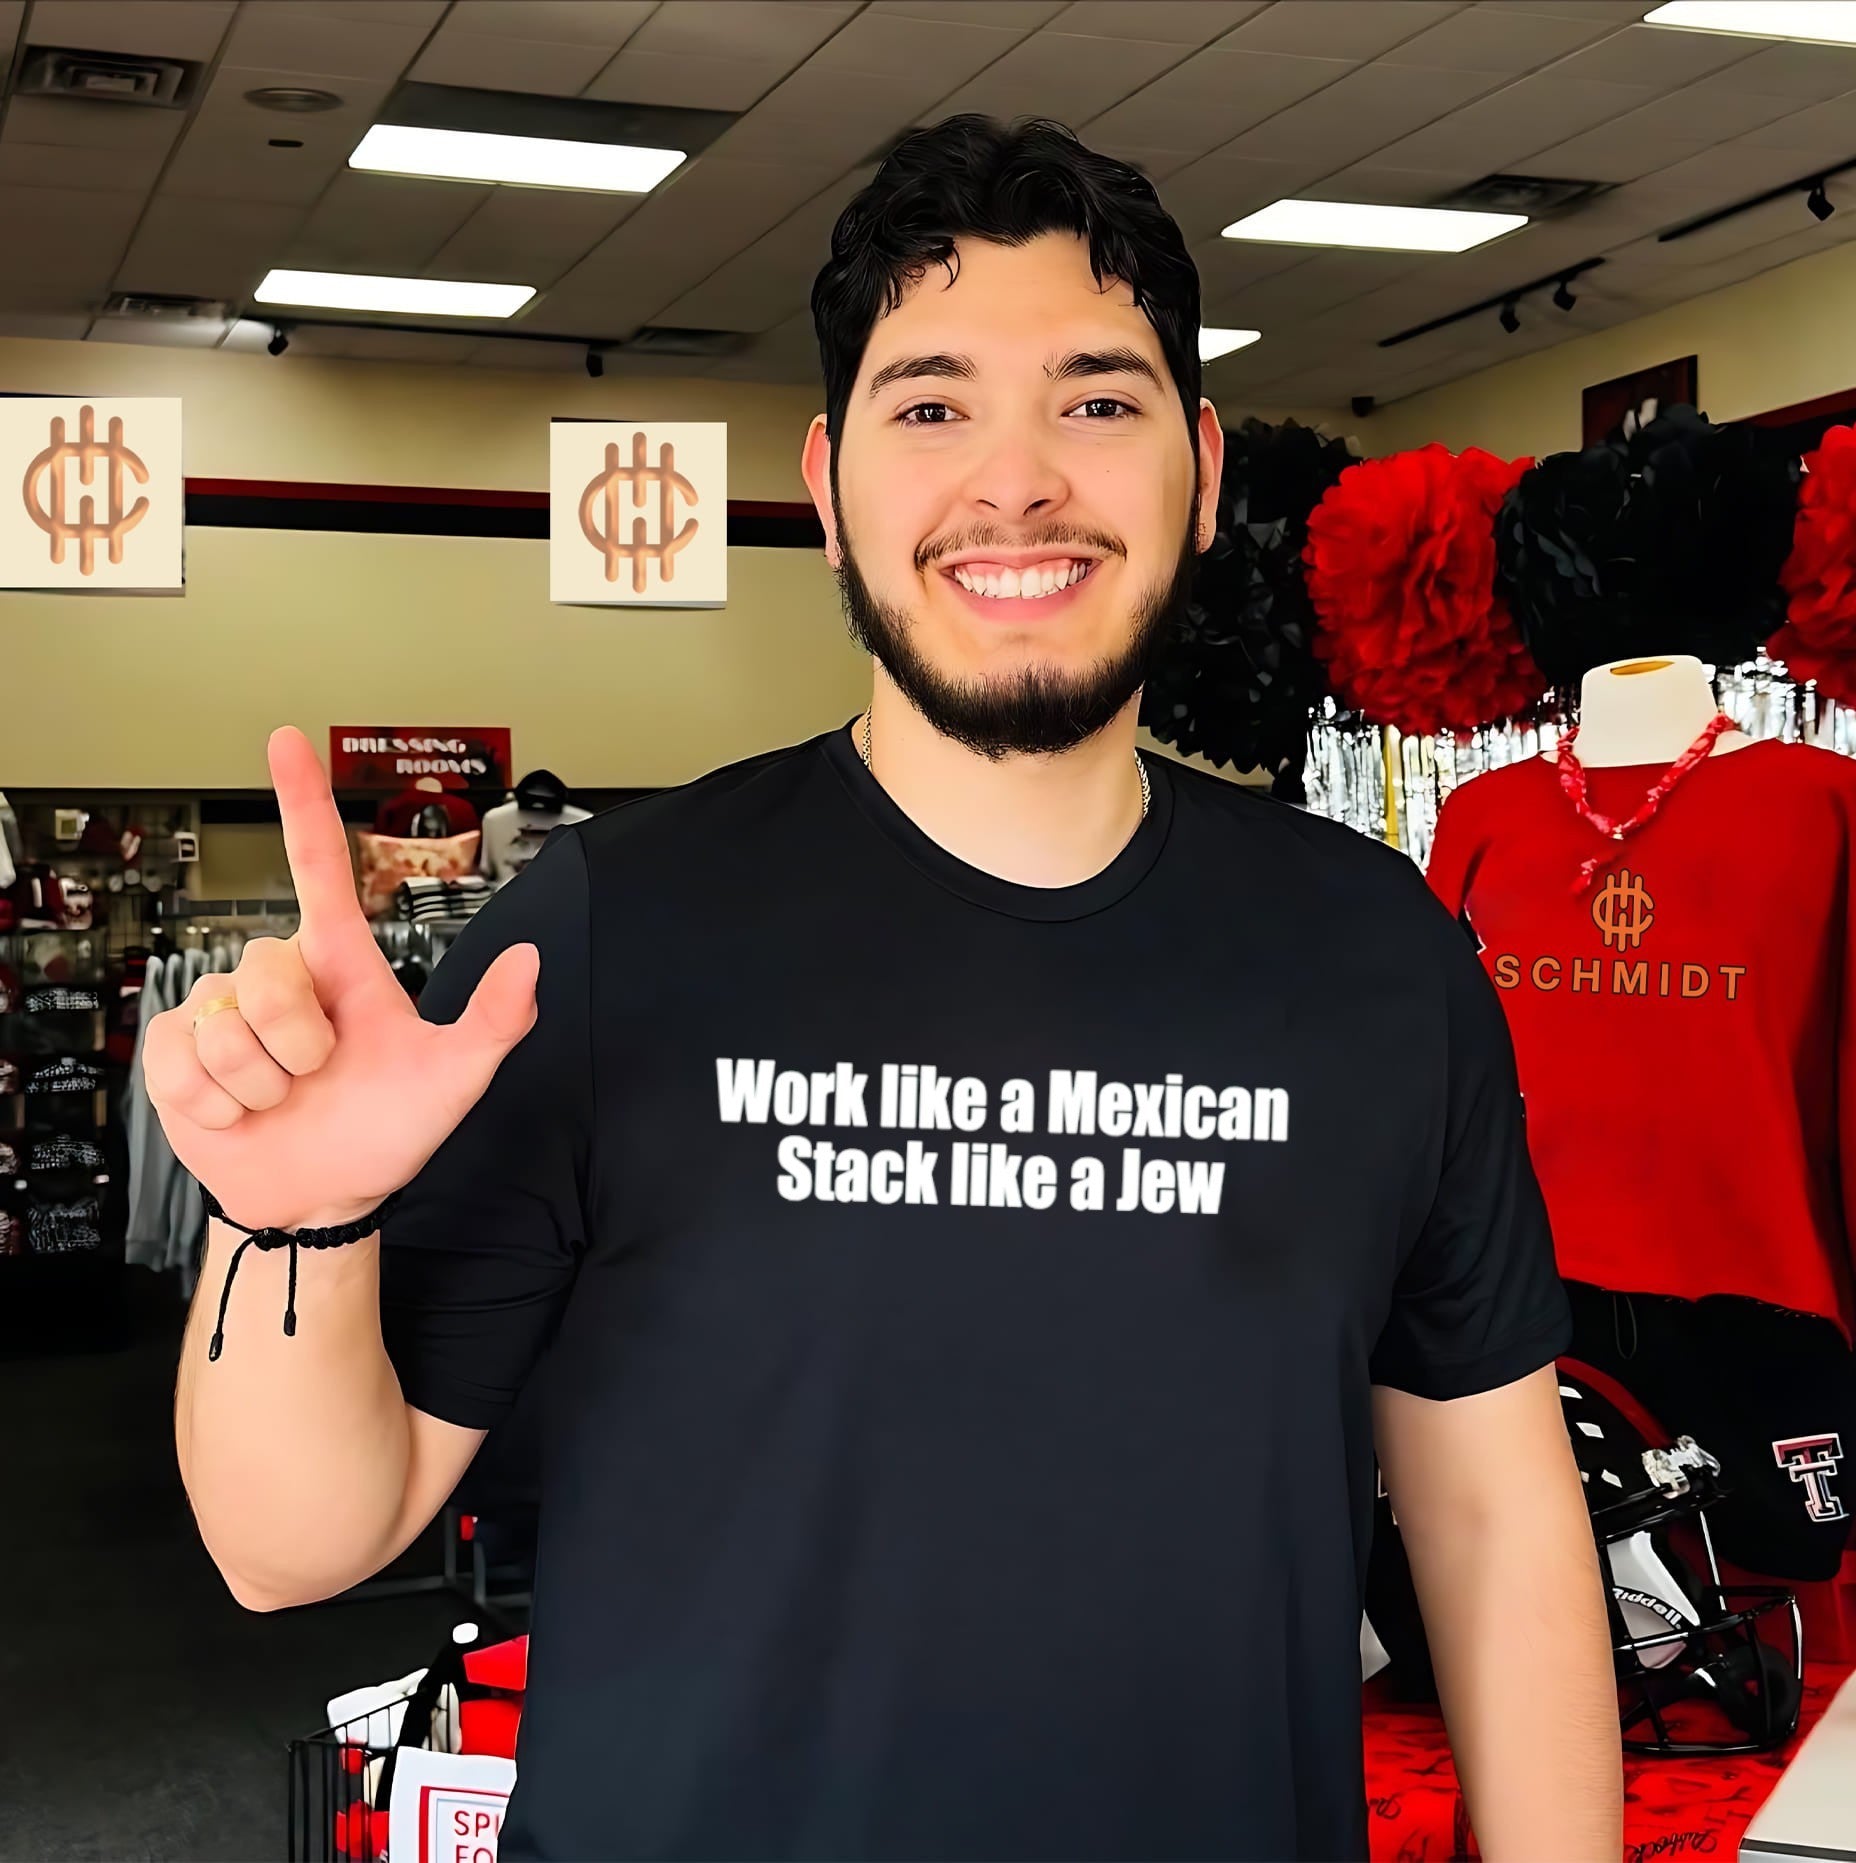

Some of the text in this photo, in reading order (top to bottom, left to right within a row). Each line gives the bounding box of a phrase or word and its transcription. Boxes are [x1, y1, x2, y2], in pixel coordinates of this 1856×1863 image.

[396, 758, 488, 775] ROOMS
[1495, 953, 1747, 1001] SCHMIDT
[716, 1058, 1289, 1141] Work like a Mexican
[777, 1135, 1225, 1214] Stack like a Jew
